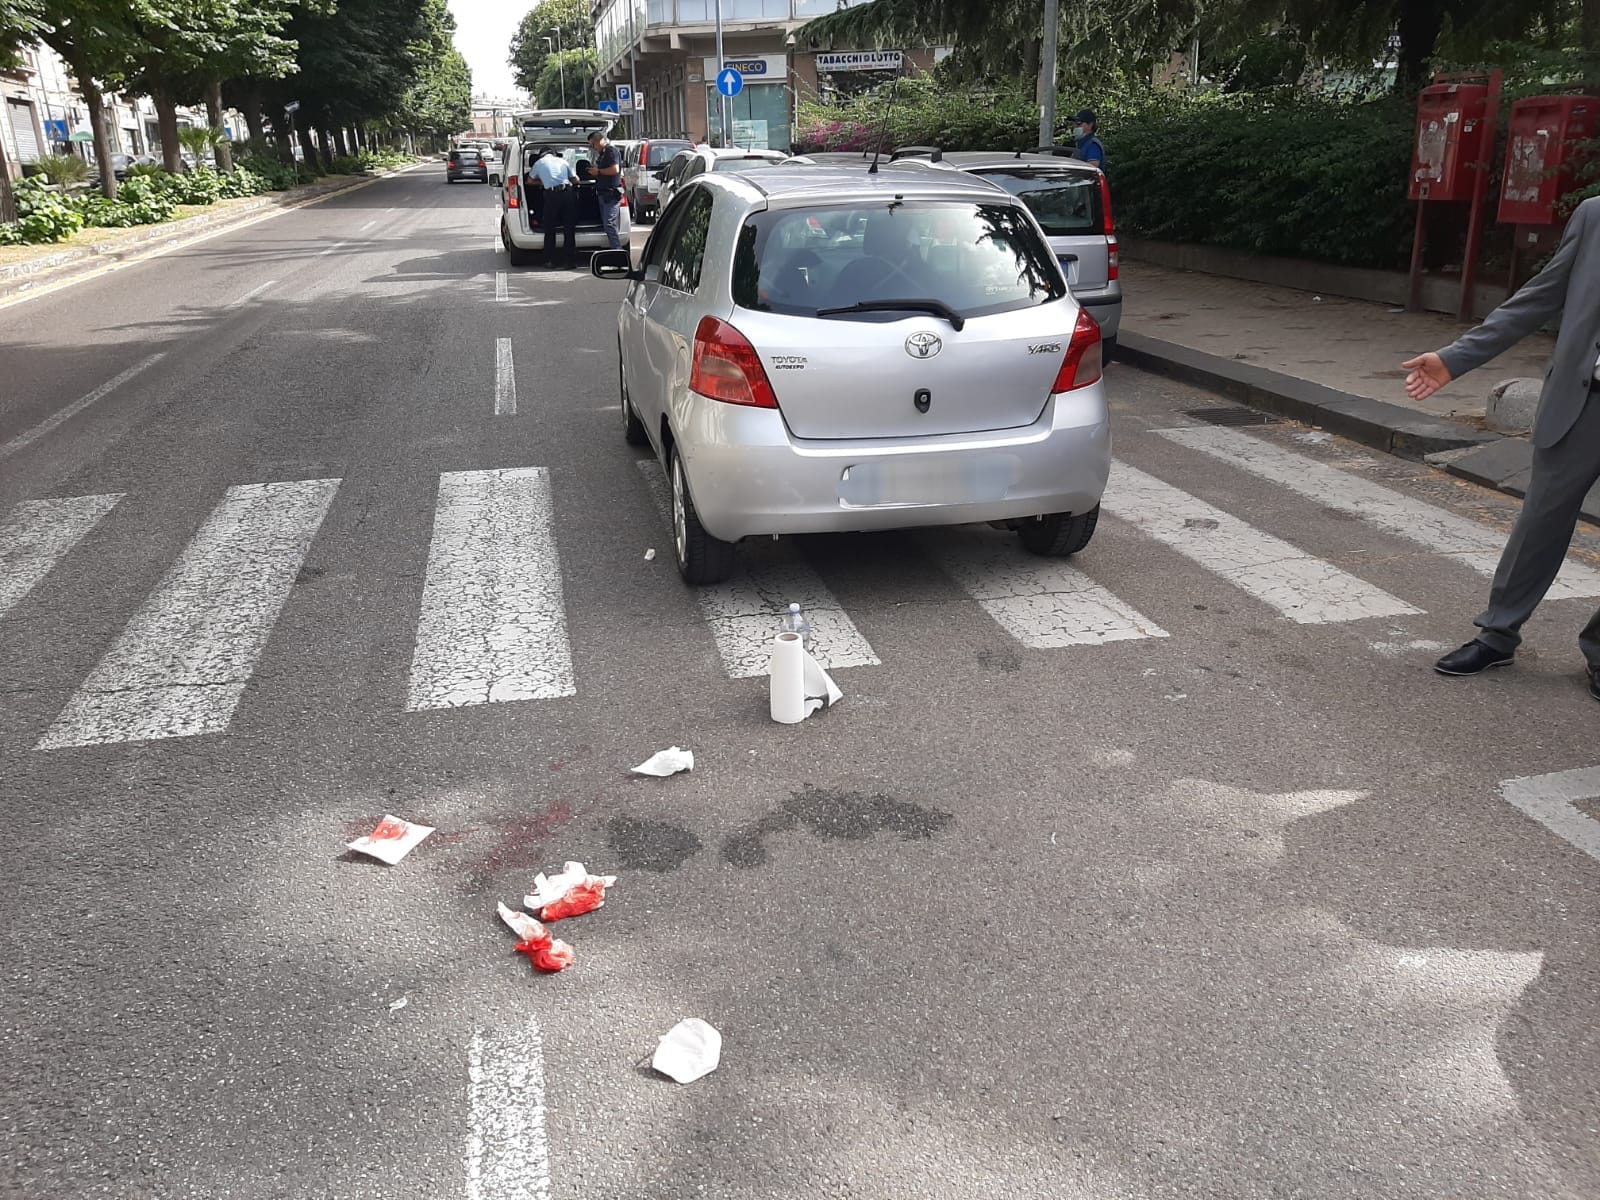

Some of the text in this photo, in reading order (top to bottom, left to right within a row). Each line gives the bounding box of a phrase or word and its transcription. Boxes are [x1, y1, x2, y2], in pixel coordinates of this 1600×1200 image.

[819, 53, 900, 64] TABACCHI LOTTO
[621, 88, 628, 98] P
[1028, 342, 1061, 354] YARIS
[770, 356, 808, 364] TOYOTA
